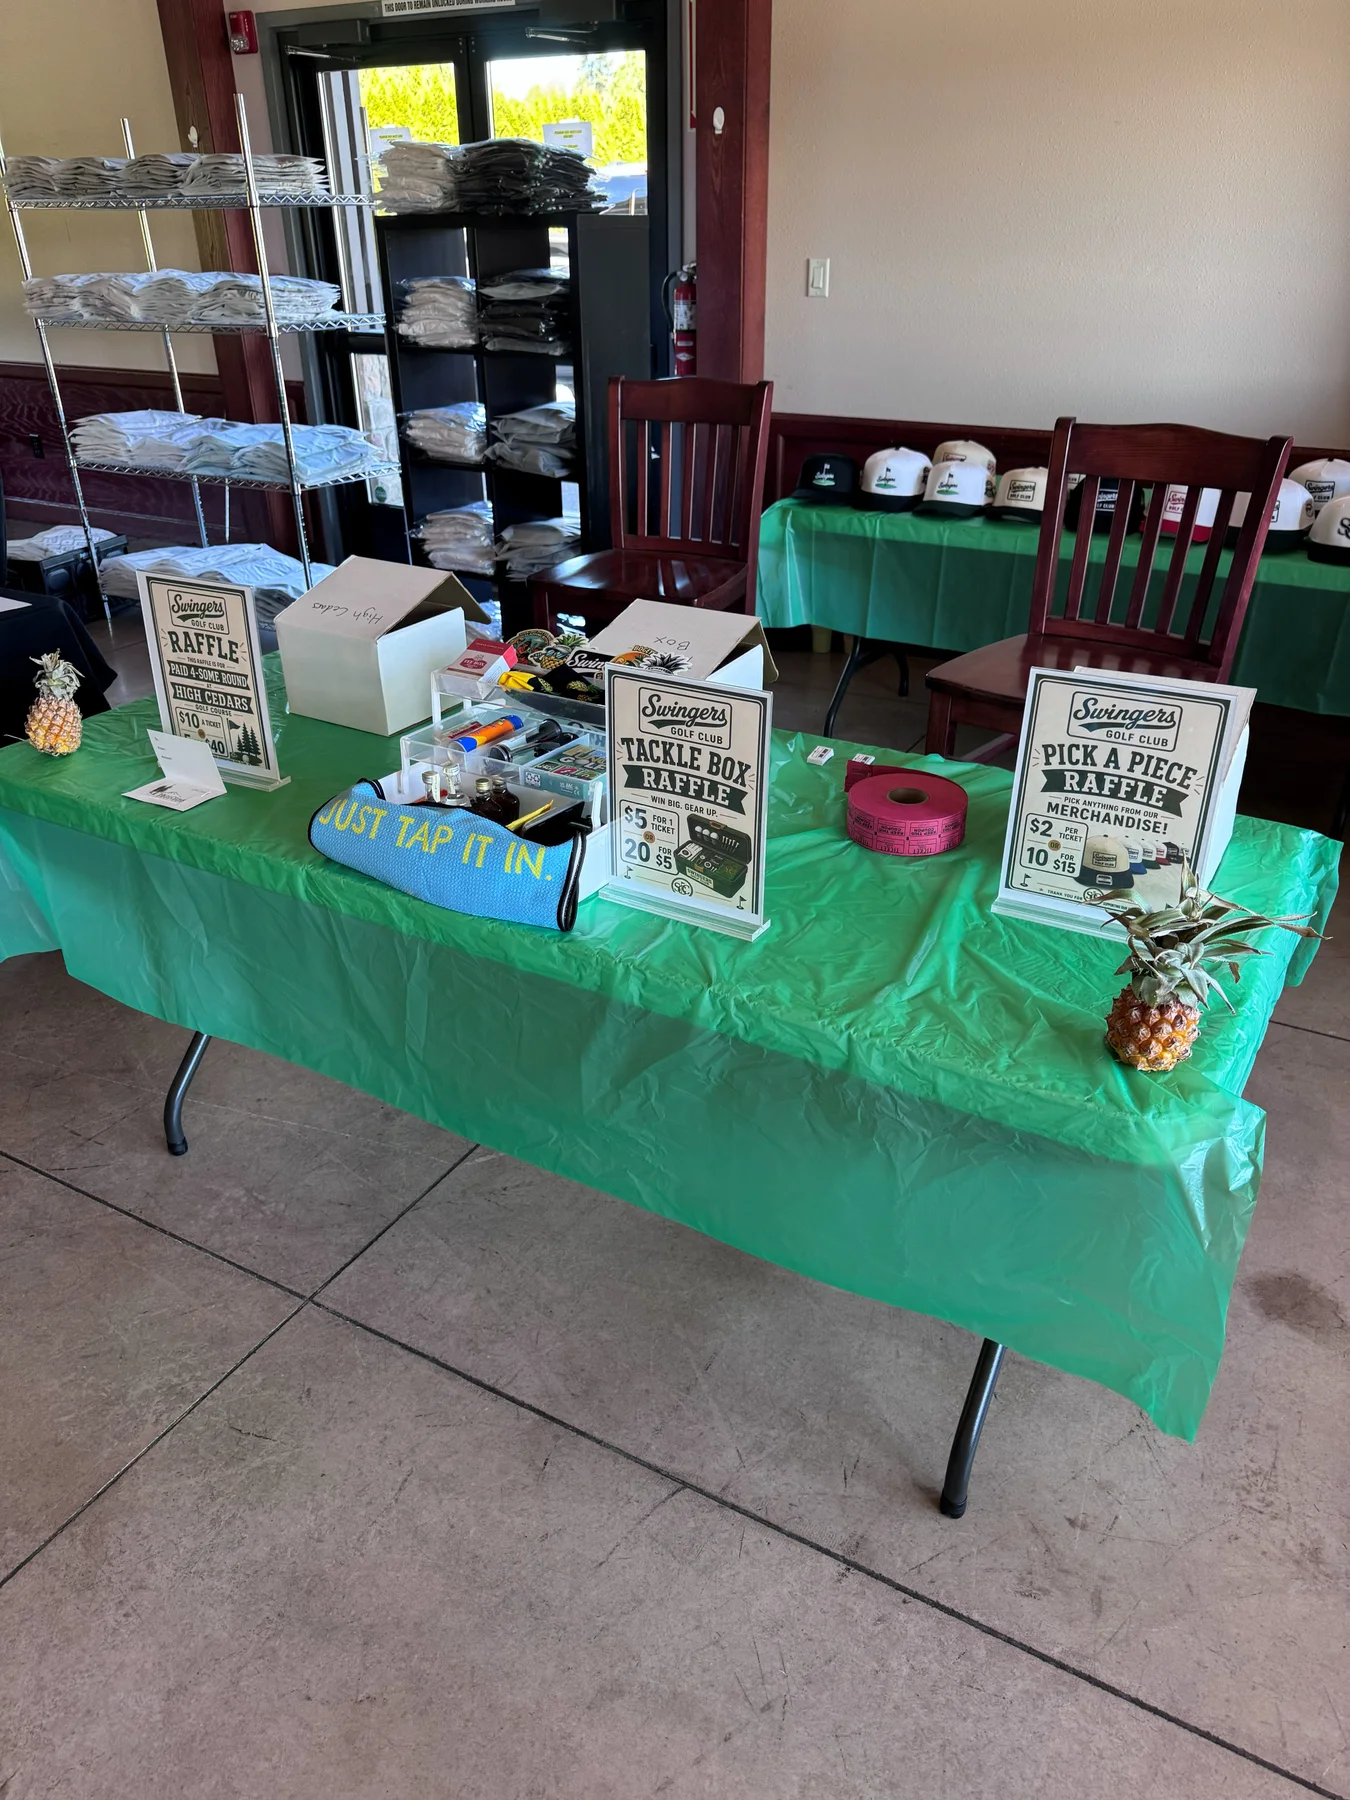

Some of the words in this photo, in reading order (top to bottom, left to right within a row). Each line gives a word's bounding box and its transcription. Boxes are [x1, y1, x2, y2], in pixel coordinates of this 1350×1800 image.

[385, 4, 394, 12] THIS
[395, 3, 407, 12] DOOR
[414, 1, 431, 10] REMAIN
[172, 594, 224, 621] Swingers
[312, 602, 348, 617] Cedars
[352, 606, 384, 624] High
[191, 620, 206, 628] GOLF
[208, 622, 224, 632] CLUB
[168, 630, 239, 664] RAFFLE
[170, 664, 188, 676] PAID
[190, 666, 220, 682] 4-SOME
[221, 672, 248, 688] ROUND
[174, 685, 202, 702] HIGH
[204, 691, 249, 710] CEDARS
[179, 710, 200, 729] $10
[210, 707, 232, 717] COURSE
[642, 694, 728, 729] Swingers
[1072, 698, 1176, 732] Swingers
[206, 720, 221, 728] TICKET
[670, 726, 694, 739] GOLF
[698, 732, 724, 745] CLUB
[1106, 730, 1134, 742] GOLF
[1138, 734, 1168, 747] CLUB
[620, 737, 702, 772] TACKLE
[706, 750, 752, 788] BOX
[1042, 743, 1098, 767] PICK
[1103, 747, 1120, 770] A
[1127, 750, 1198, 790] PIECE
[642, 768, 730, 806] RAFFLE
[1063, 771, 1168, 808] RAFFLE
[650, 794, 666, 806] WIN
[668, 798, 682, 810] BIG.
[684, 803, 704, 815] GEAR
[706, 808, 718, 818] UP.
[1064, 796, 1080, 806] PICK
[1082, 800, 1118, 812] ANYTHING
[1121, 806, 1142, 816] FROM
[1144, 810, 1158, 819] OUR
[624, 805, 648, 830] $5
[652, 814, 668, 825] FOR
[669, 818, 674, 827] 1
[1030, 817, 1053, 838] $2
[1046, 802, 1168, 835] MERCHANDISE!
[650, 822, 676, 836] TICKET
[1058, 832, 1082, 843] TICKET
[1065, 826, 1079, 835] PER
[318, 799, 388, 840] JUST
[395, 815, 454, 854] TAP
[462, 832, 494, 868] IT
[504, 841, 553, 881] IN.
[1050, 841, 1060, 850] OR
[624, 838, 650, 863] 20
[658, 846, 672, 856] FOR
[1026, 846, 1048, 868] 10
[1060, 852, 1074, 862] FOR
[655, 853, 672, 870] $5
[1053, 858, 1076, 874] $15
